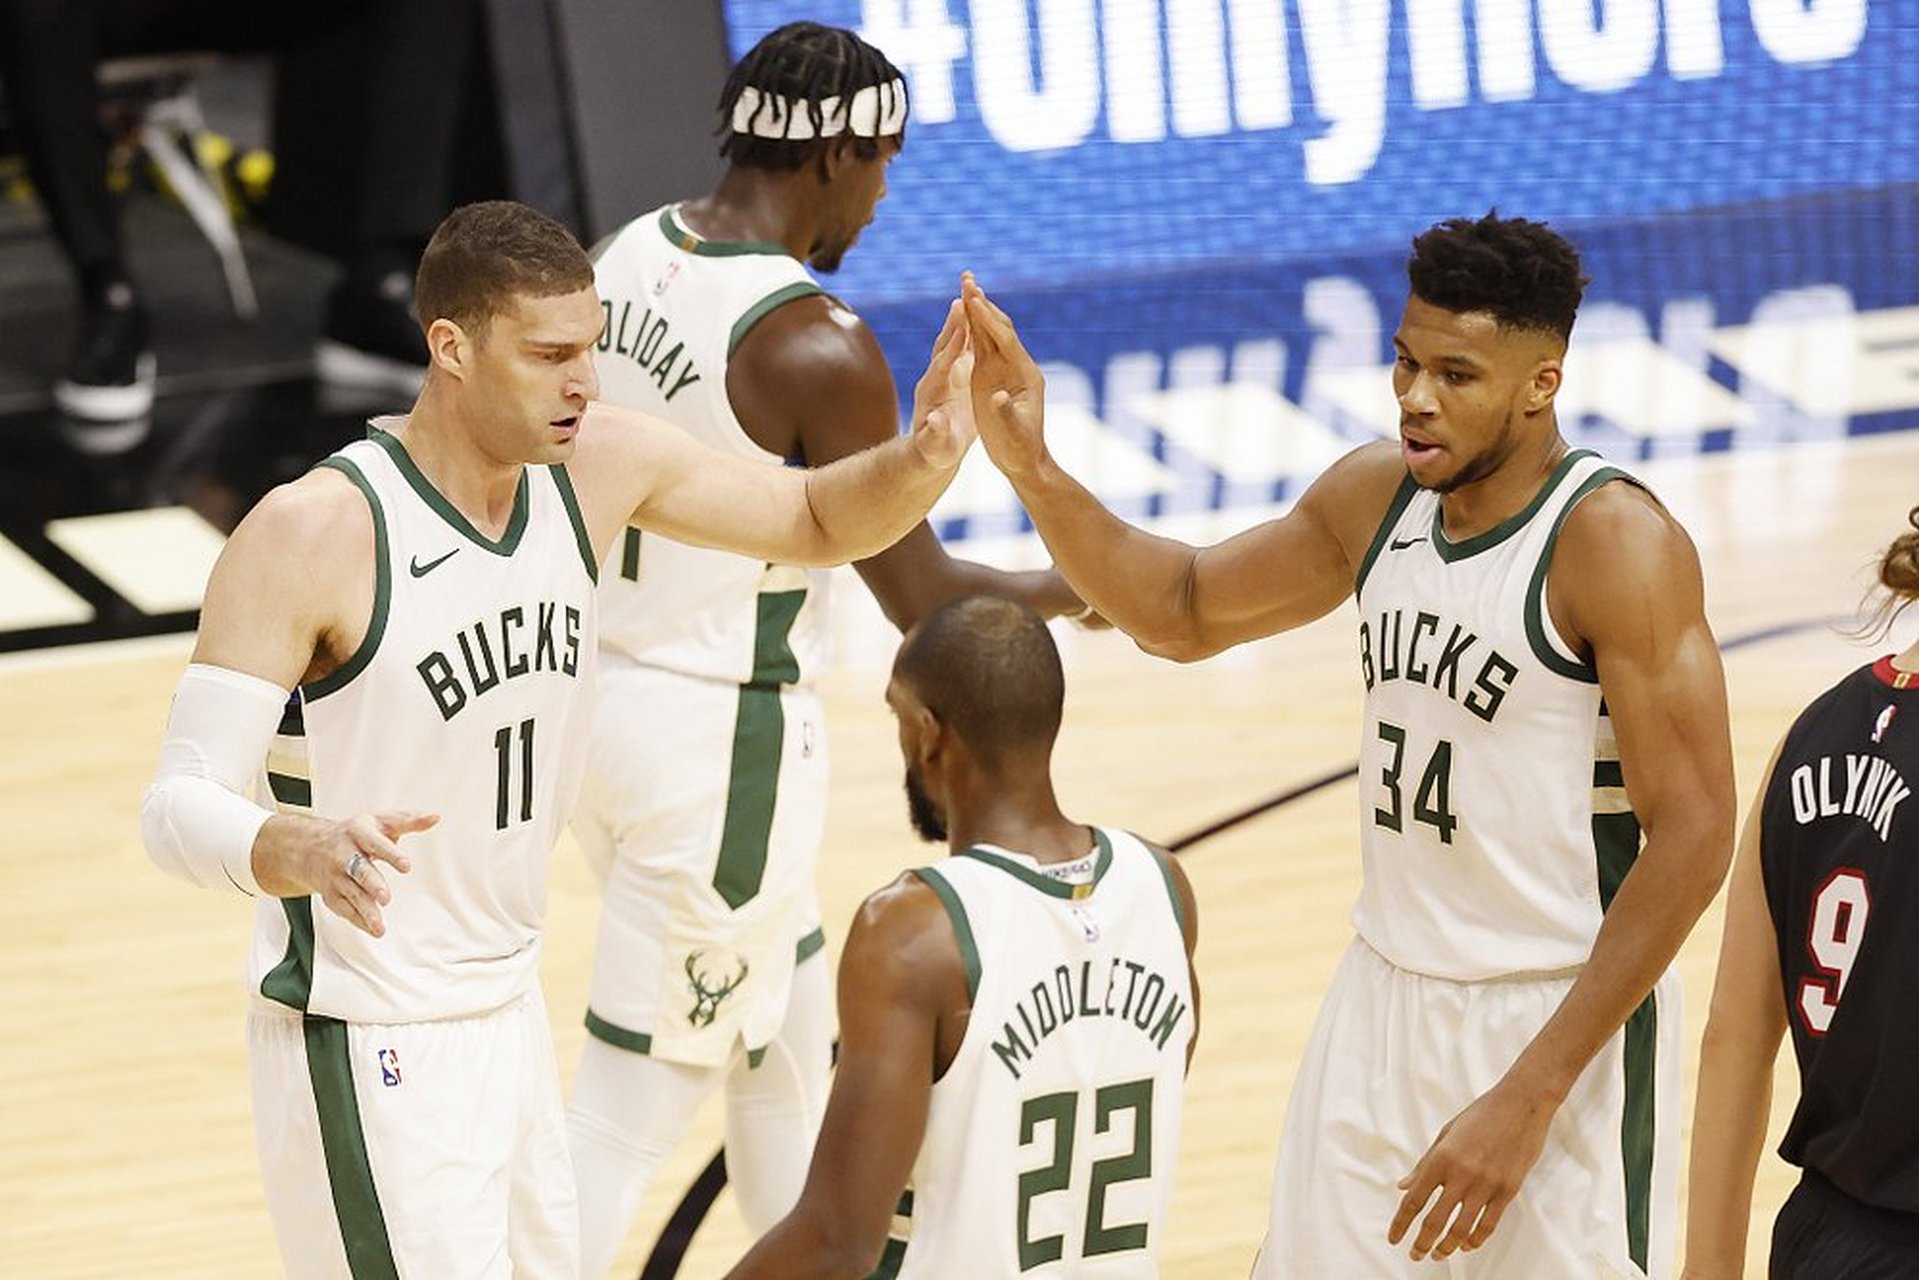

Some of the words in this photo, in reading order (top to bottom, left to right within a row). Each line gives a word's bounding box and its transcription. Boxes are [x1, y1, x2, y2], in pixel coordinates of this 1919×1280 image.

[597, 299, 701, 402] OLIDAY
[416, 602, 581, 722] BUCKS
[1359, 609, 1519, 723] BUCKS
[494, 718, 536, 830] 11
[1375, 721, 1458, 845] 34
[1799, 866, 1870, 1037] 9
[991, 958, 1186, 1080] MIDDLETON
[1016, 1077, 1154, 1273] 22
